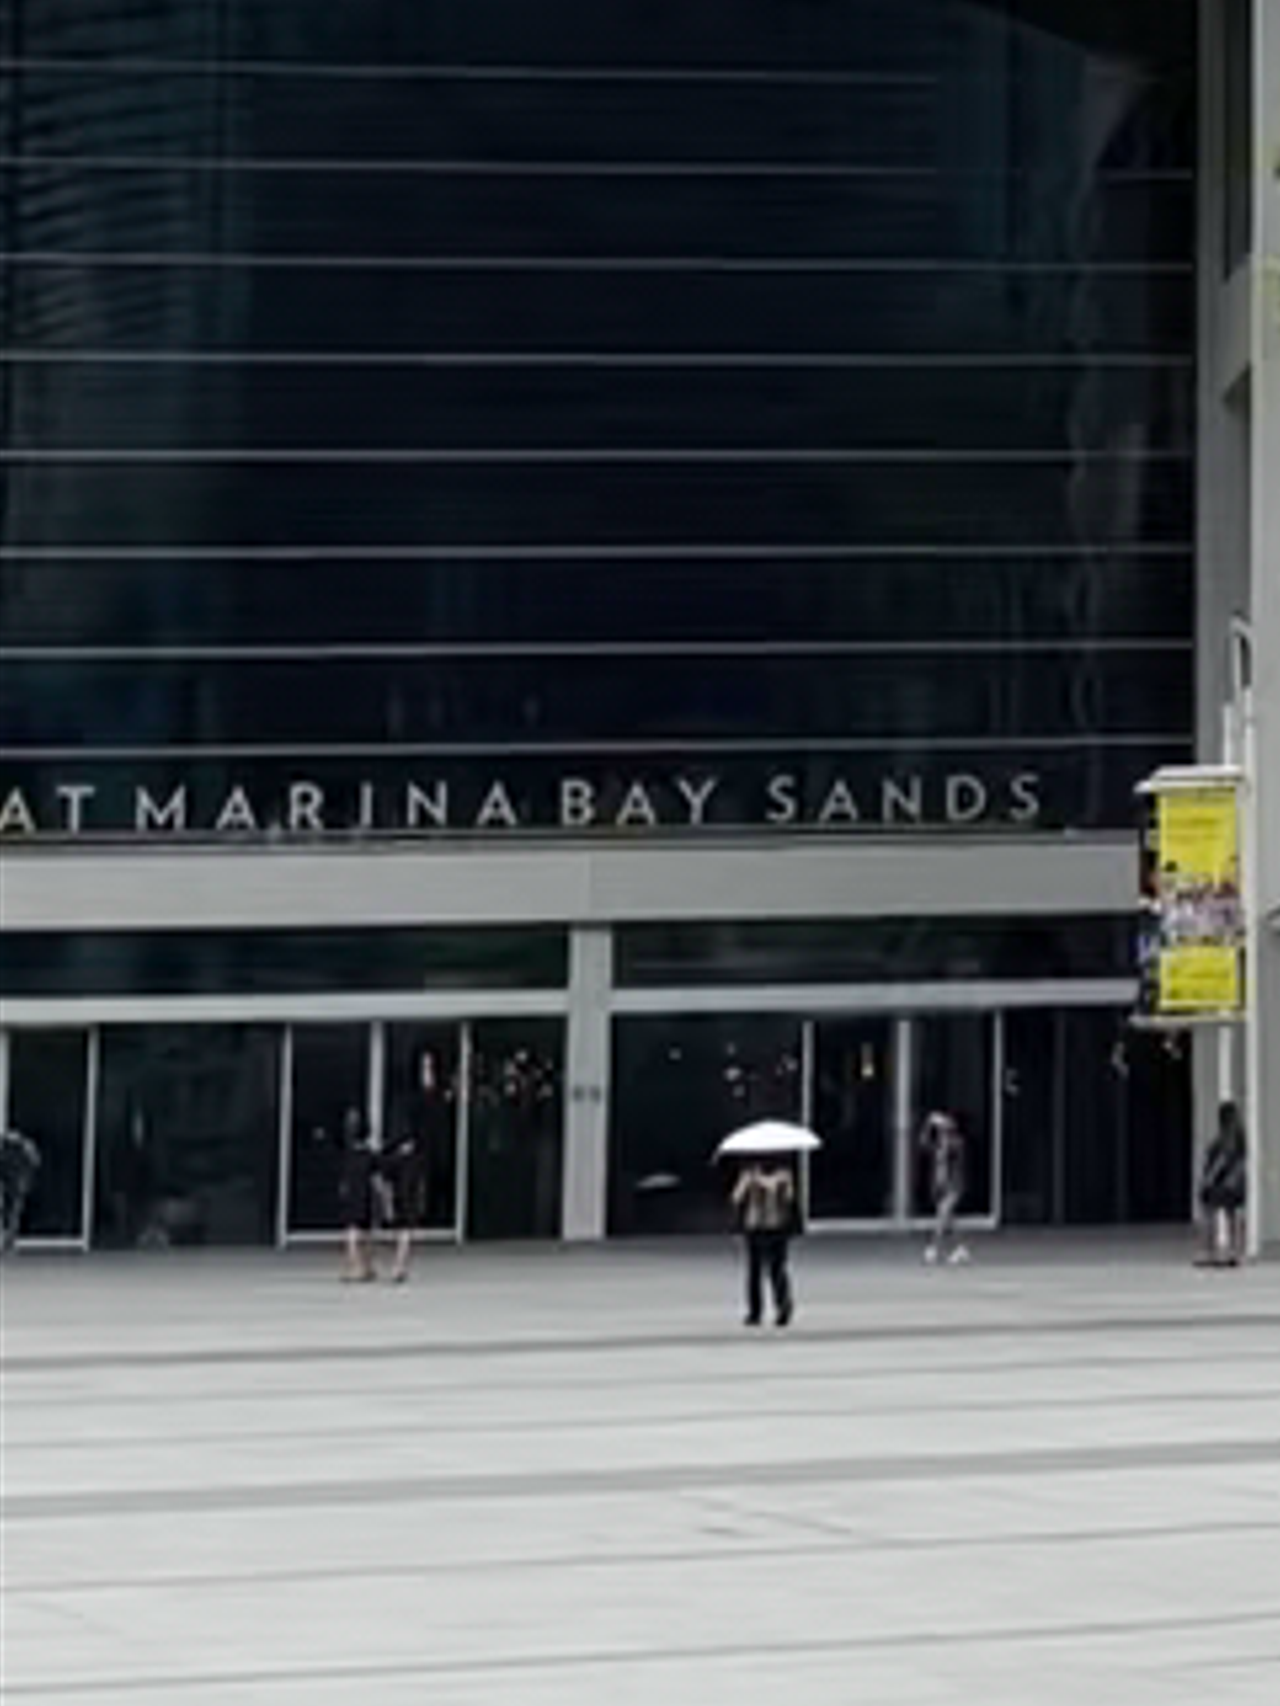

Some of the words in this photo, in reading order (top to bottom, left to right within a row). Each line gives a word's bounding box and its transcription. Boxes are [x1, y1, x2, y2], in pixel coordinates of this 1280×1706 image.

[0, 785, 95, 833] AT
[134, 782, 519, 832] MARINA
[560, 777, 716, 827] BAY
[764, 773, 1042, 824] SANDS
